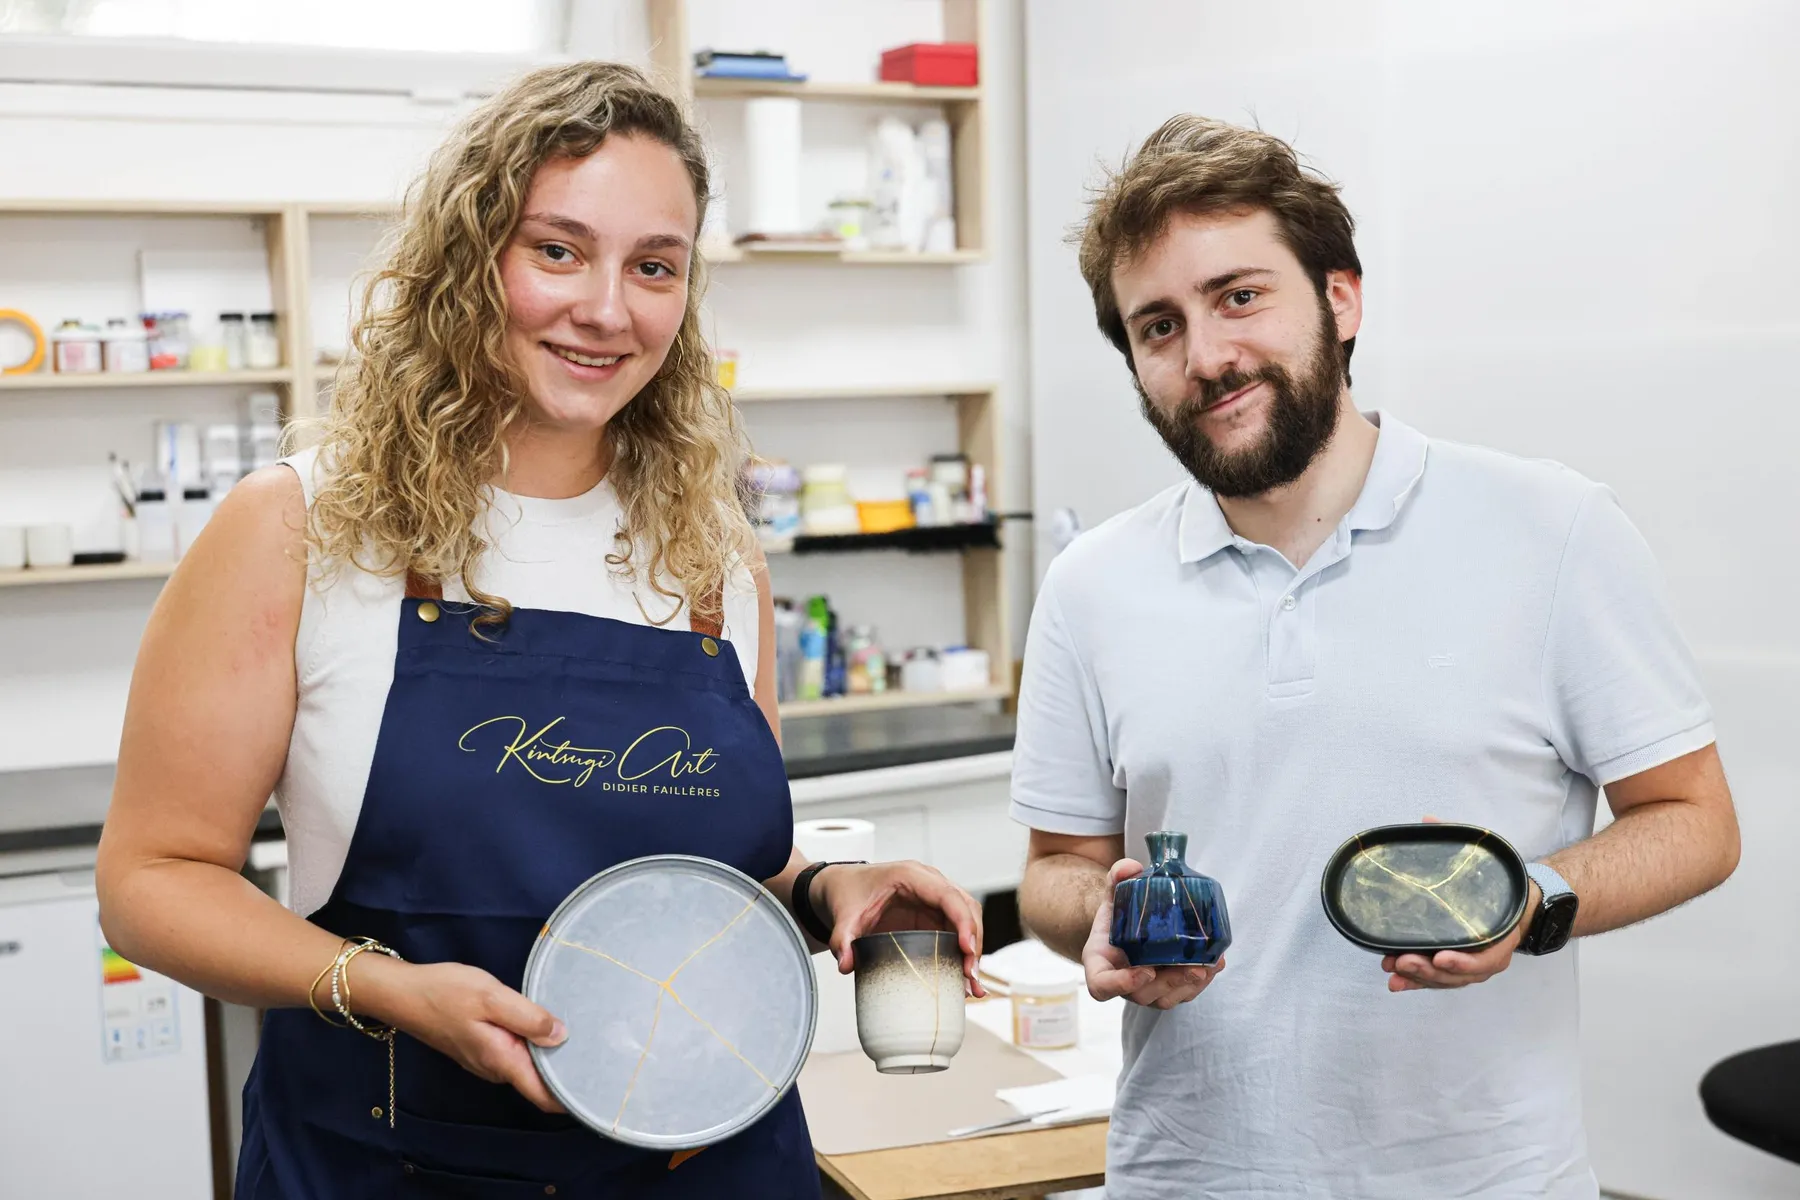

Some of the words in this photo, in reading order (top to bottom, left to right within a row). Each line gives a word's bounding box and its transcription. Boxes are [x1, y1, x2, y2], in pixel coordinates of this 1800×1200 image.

[459, 716, 616, 787] Kintsugi
[617, 726, 720, 781] Art
[602, 782, 648, 794] DIDIER
[653, 785, 720, 798] FAILLÈRES
